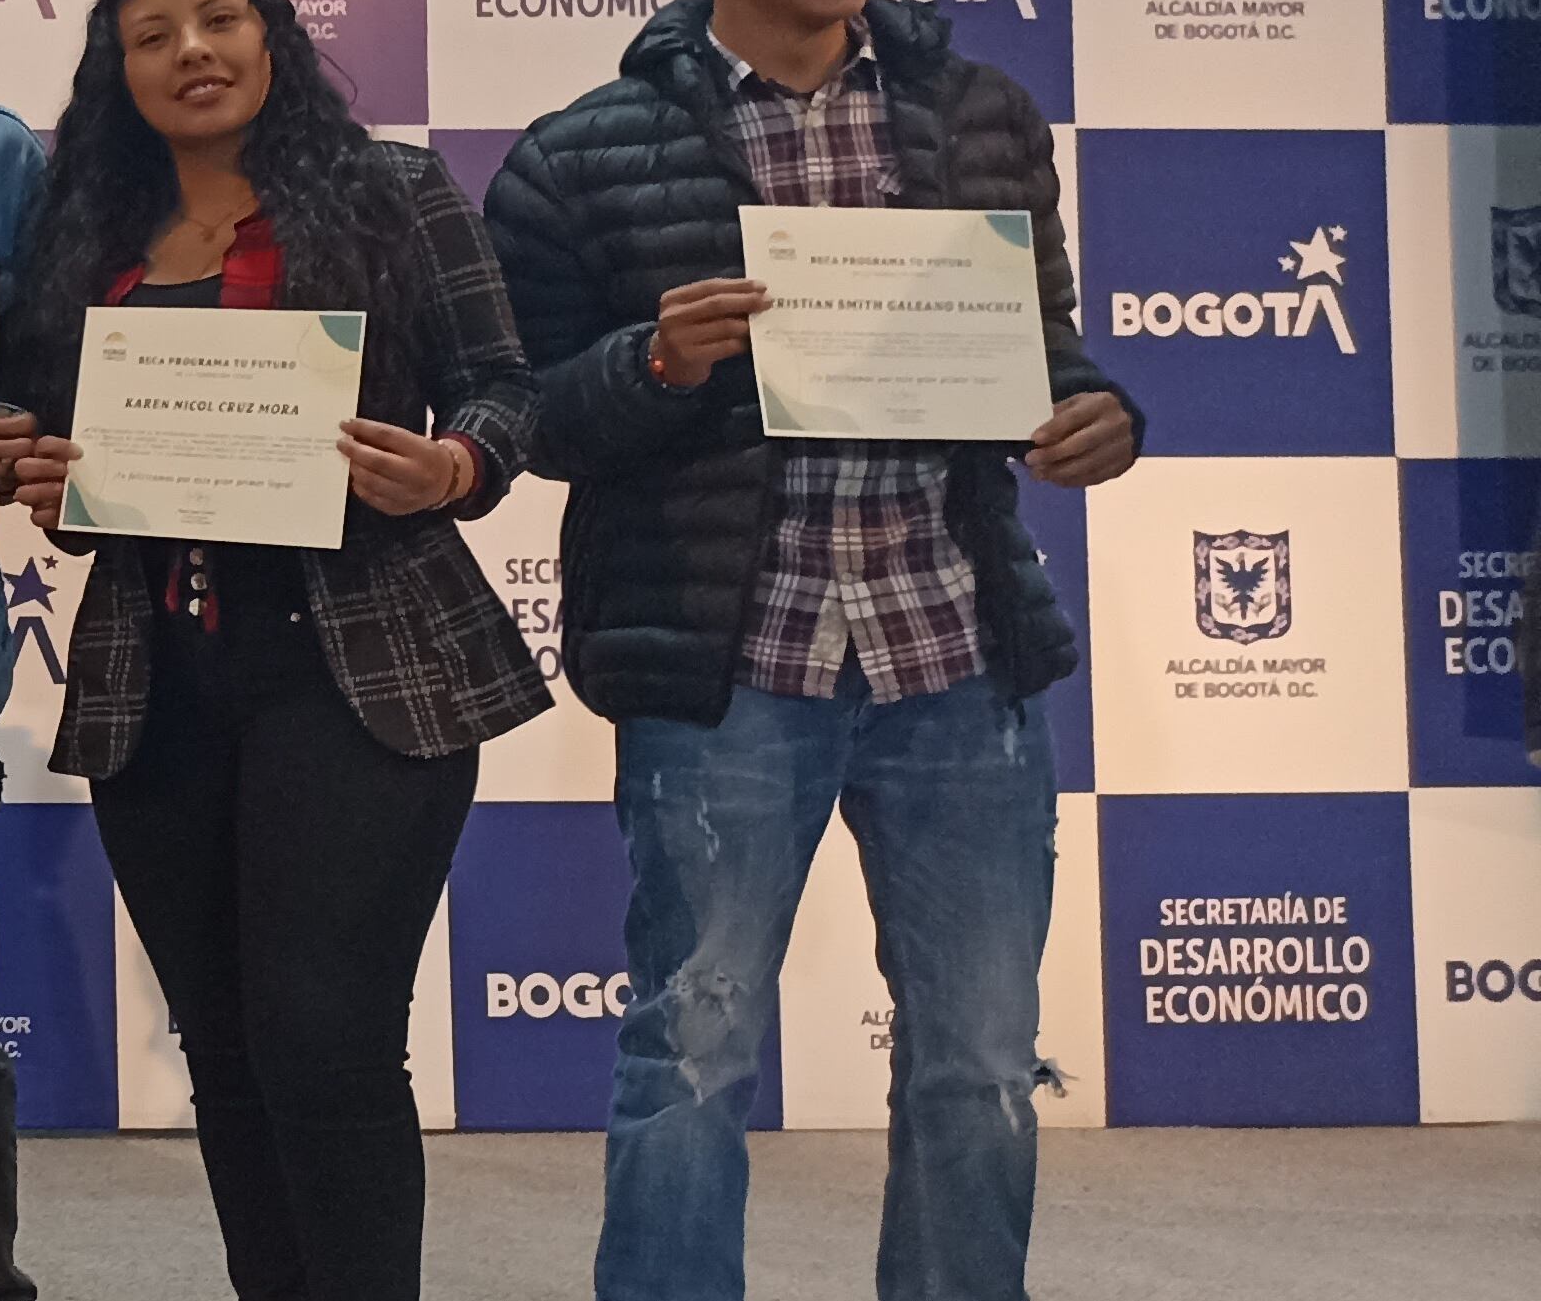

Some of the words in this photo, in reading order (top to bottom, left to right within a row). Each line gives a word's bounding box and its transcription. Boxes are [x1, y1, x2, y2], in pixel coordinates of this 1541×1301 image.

[296, 0, 347, 17] AYOR
[1242, 0, 1305, 17] MAYOR
[1155, 23, 1179, 39] DE
[1184, 20, 1259, 40] BOGOTÁ
[770, 297, 834, 311] RISTIAN
[125, 397, 170, 410] KAREN
[173, 399, 215, 413] NICOL
[218, 400, 256, 415] CRUZ
[259, 402, 300, 416] MORA
[1165, 655, 1257, 676] ALCALDÍA
[1262, 657, 1327, 675] MAYOR
[1175, 681, 1198, 699] DE
[1204, 678, 1280, 699] BOGOTÁ
[1160, 891, 1308, 926] SECRETARÍA
[1315, 897, 1347, 925] DE
[1139, 936, 1370, 976] DESARROLLO
[1445, 958, 1541, 1003] BOG
[486, 972, 637, 1018] BOGO
[1145, 977, 1368, 1024] ECONÓMICO
